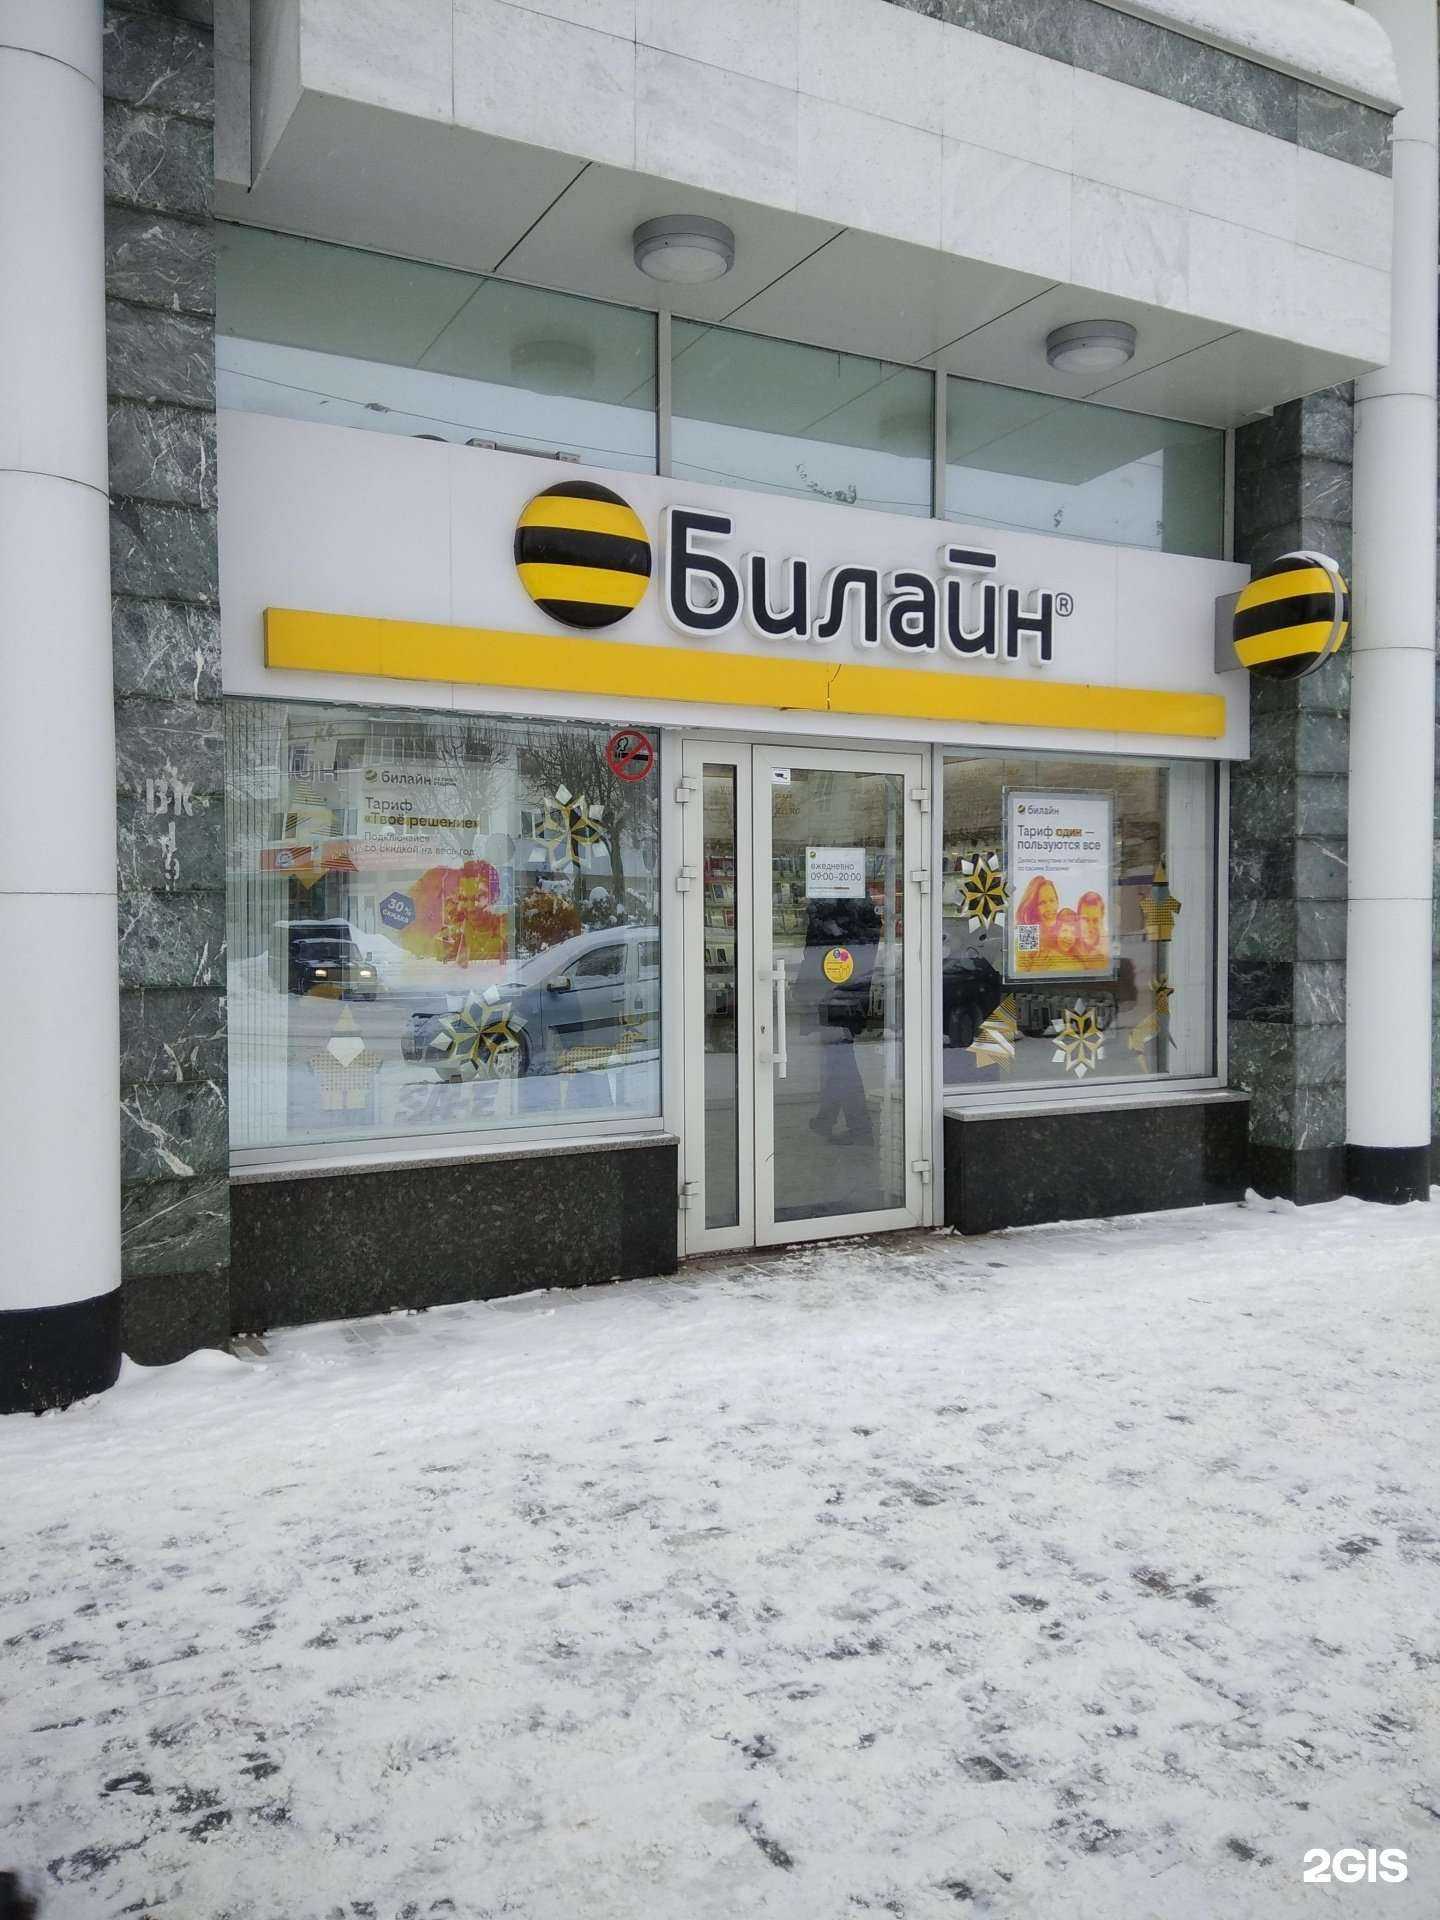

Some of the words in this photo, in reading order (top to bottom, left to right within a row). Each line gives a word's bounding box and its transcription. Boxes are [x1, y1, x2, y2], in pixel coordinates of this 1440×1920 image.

[381, 771, 432, 786] билайн
[365, 797, 413, 812] Тариф
[1027, 805, 1060, 815] билайн
[1017, 825, 1053, 839] Тариф
[1017, 840, 1080, 853] пользуются
[1082, 841, 1101, 851] все
